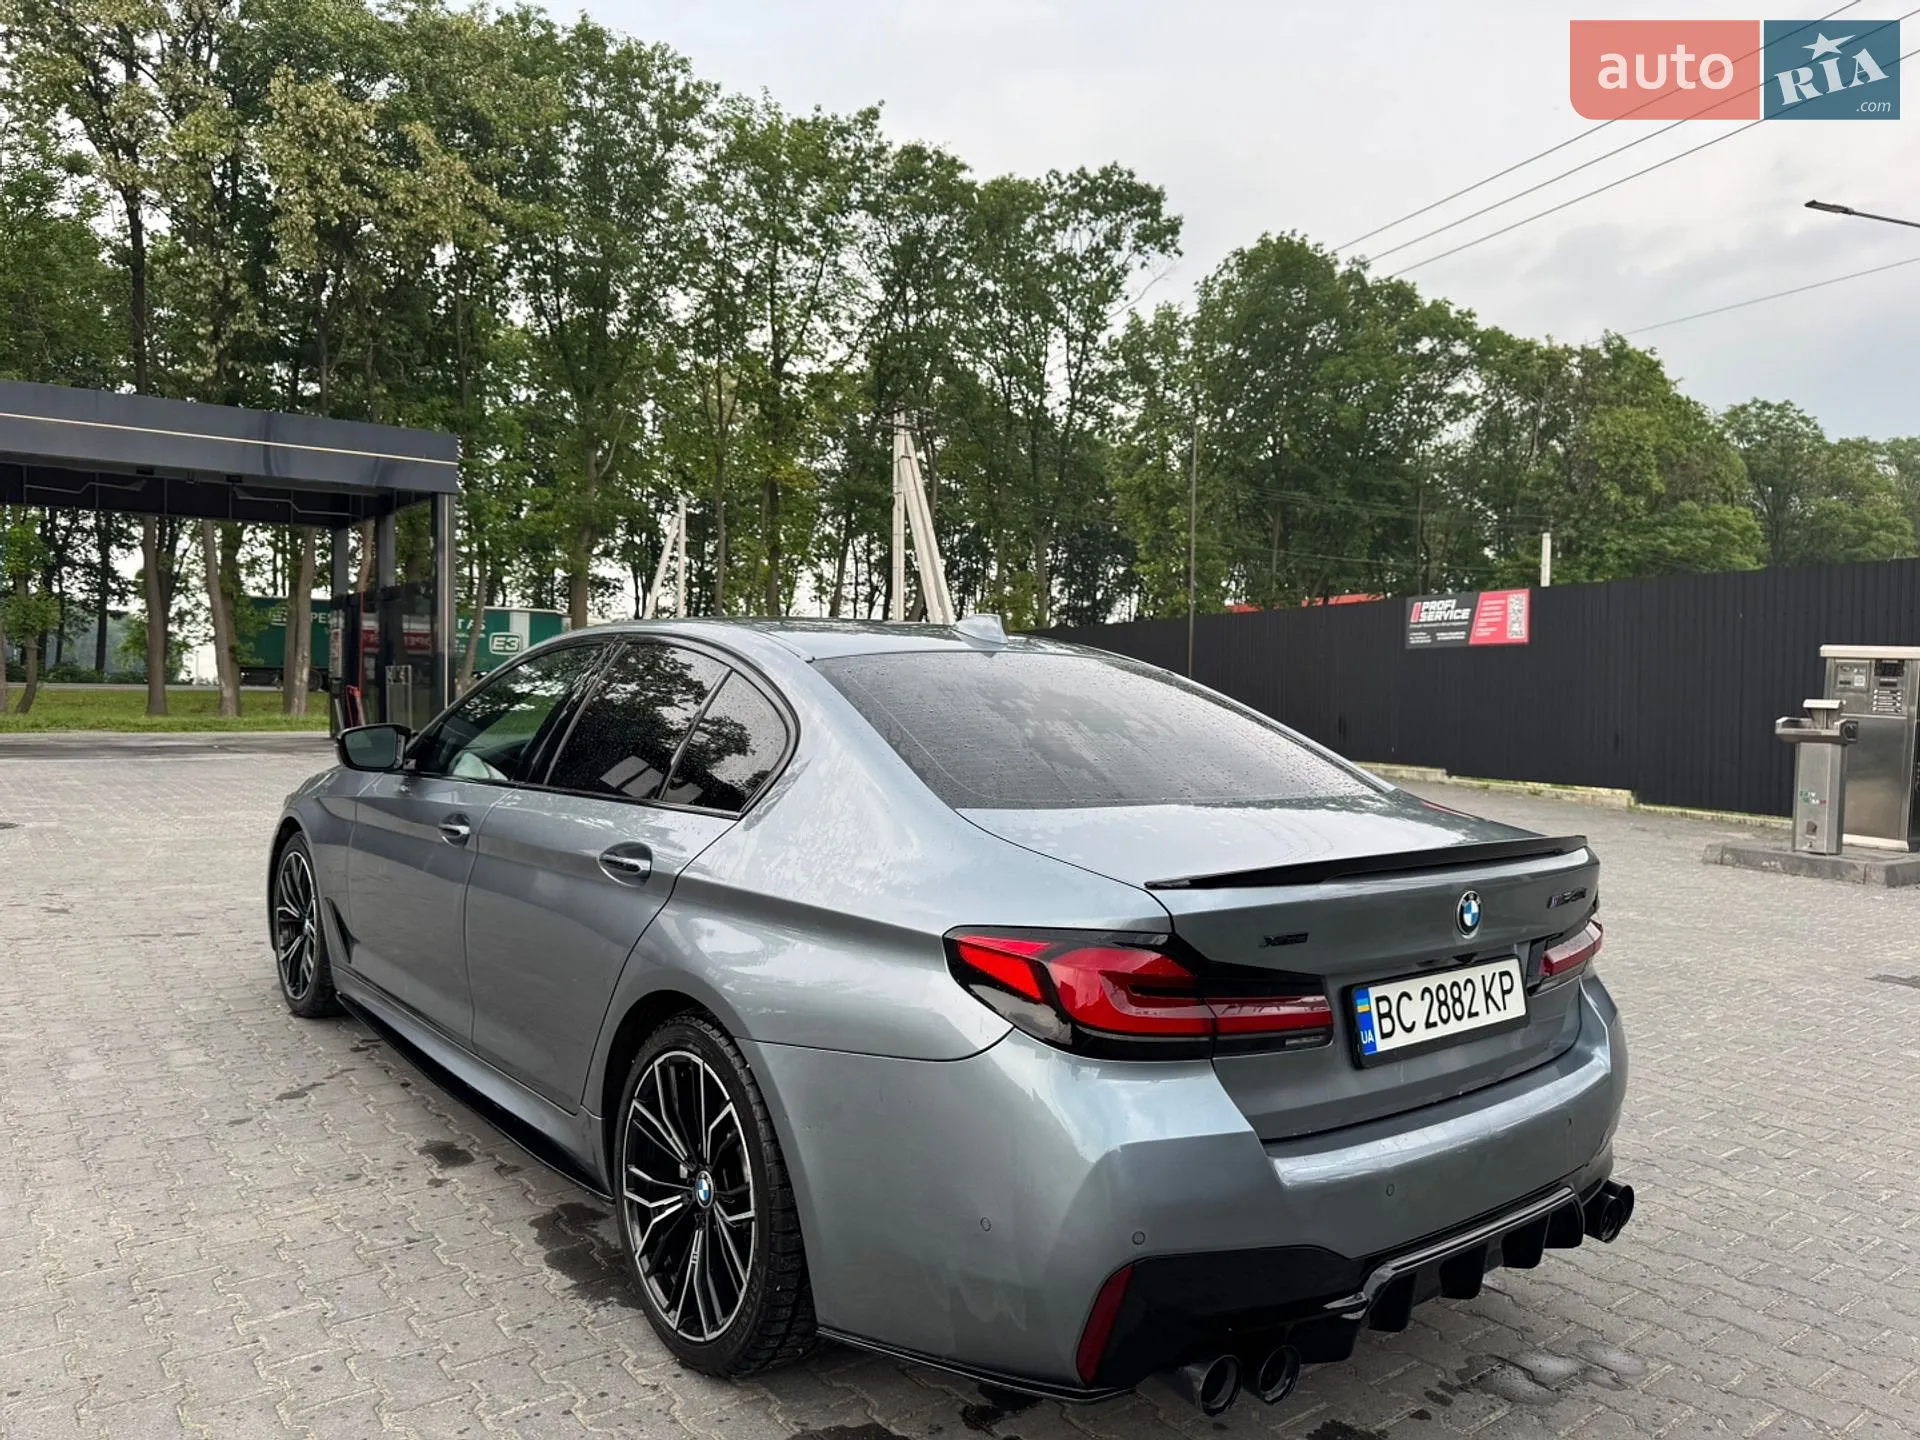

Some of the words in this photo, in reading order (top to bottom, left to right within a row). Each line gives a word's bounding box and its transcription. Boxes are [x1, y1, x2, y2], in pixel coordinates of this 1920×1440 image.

[1421, 599, 1457, 611] PROFI
[1418, 608, 1472, 622] SERVICE
[492, 636, 519, 651] E3
[1374, 991, 1416, 1040] BC
[1420, 978, 1480, 1029] 2882
[1481, 970, 1515, 1015] KP
[1360, 1029, 1375, 1045] UA
